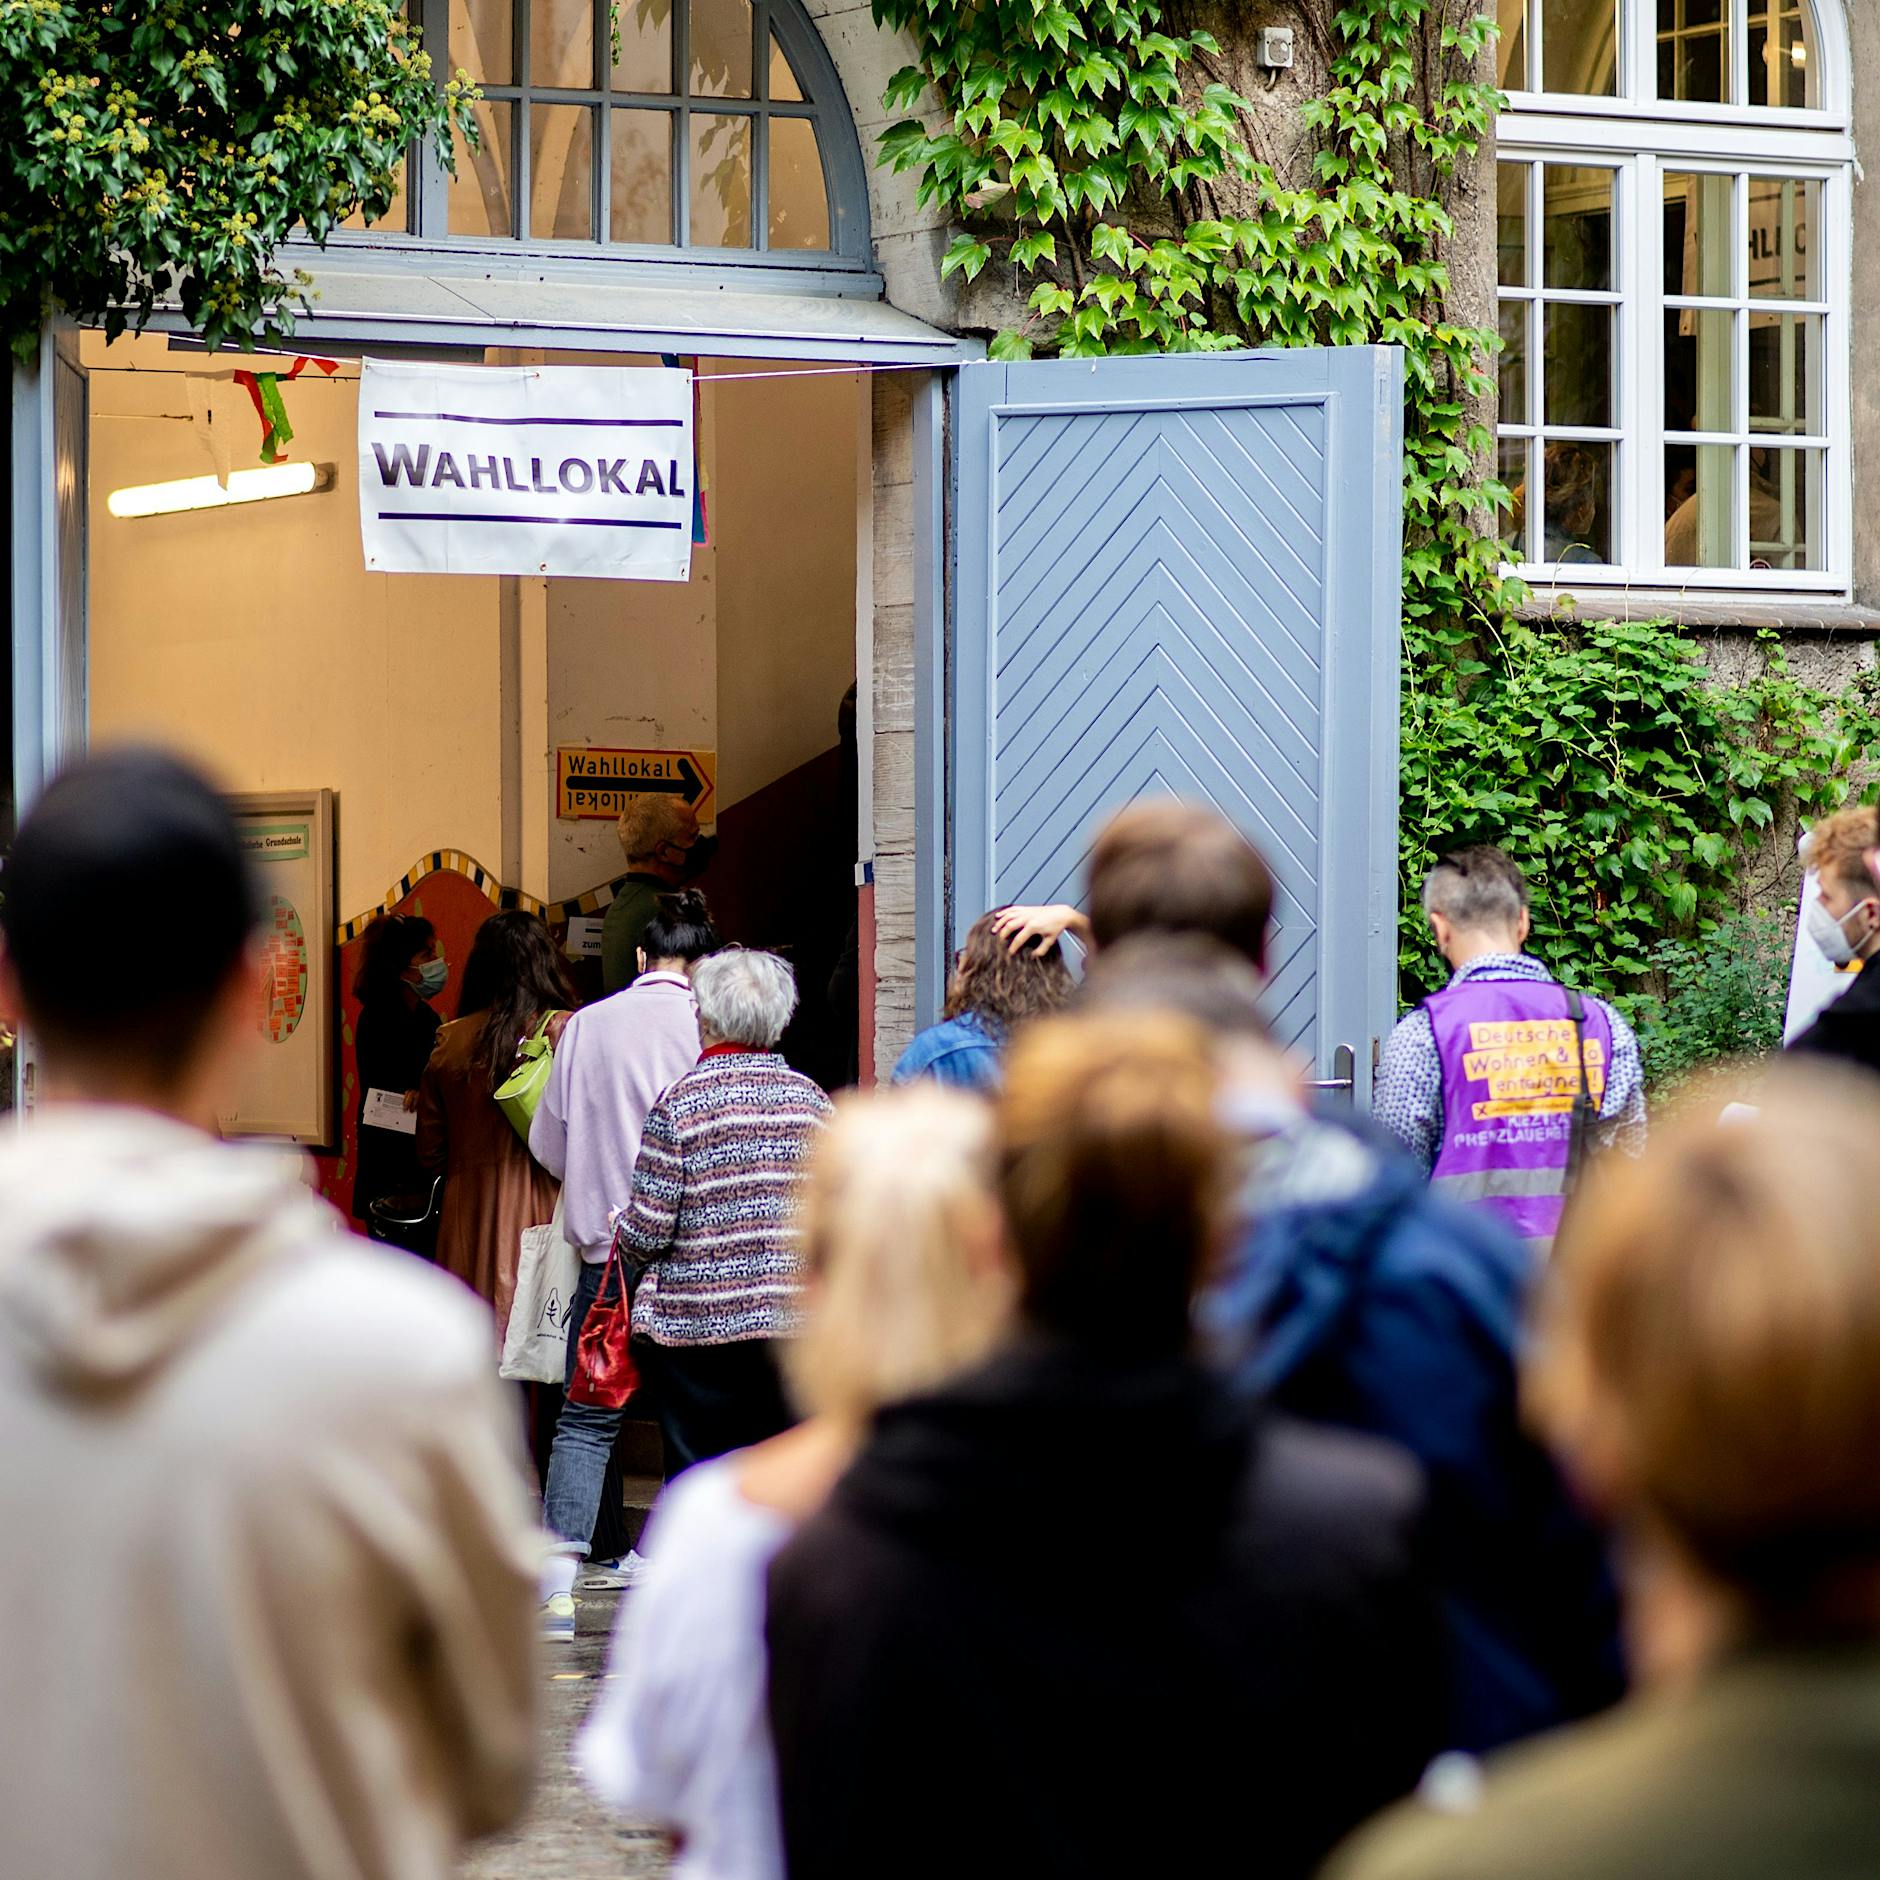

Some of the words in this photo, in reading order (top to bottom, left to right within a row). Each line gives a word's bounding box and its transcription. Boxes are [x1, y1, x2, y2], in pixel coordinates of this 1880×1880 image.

[371, 442, 686, 497] WAHLLOKAL
[568, 755, 671, 778] Wahllokal
[567, 791, 639, 812] llokal
[265, 835, 302, 848] Grundschule
[582, 940, 601, 949] zum
[1478, 1024, 1571, 1044] Deutsche
[1470, 1052, 1549, 1074] Wohnen
[1556, 1046, 1569, 1063] &
[1496, 1070, 1598, 1094] enteigne!
